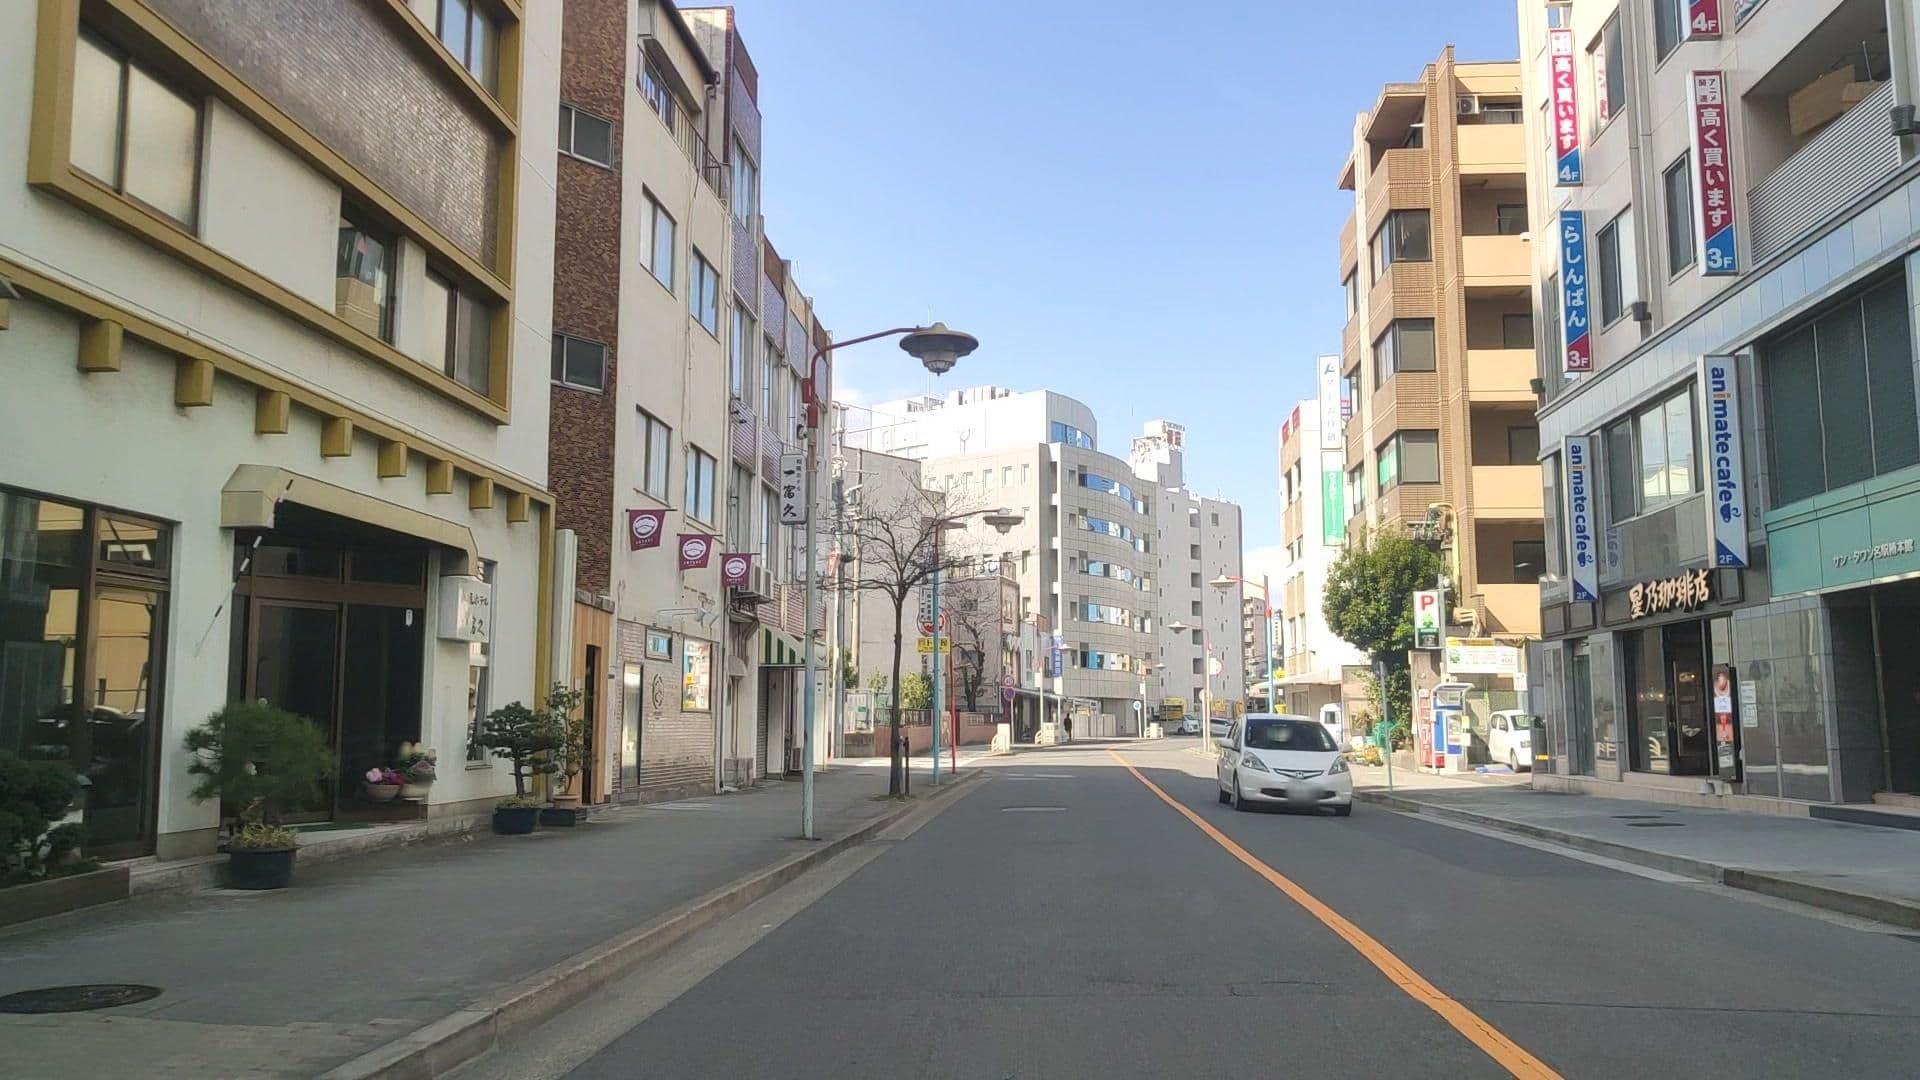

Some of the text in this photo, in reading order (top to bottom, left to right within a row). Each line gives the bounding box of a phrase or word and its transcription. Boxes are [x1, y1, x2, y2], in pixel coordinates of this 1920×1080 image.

[1692, 12, 1718, 32] 4F
[1554, 57, 1576, 150] 高く買います
[1559, 165, 1580, 181] 4F
[1700, 107, 1728, 228] 高く買います
[1707, 247, 1733, 269] 3F
[1564, 225, 1586, 327] らしんばん
[1568, 350, 1589, 368] 3F
[1719, 554, 1733, 564] 2F
[1420, 594, 1435, 610] P
[1576, 591, 1588, 600] 2F
[1629, 568, 1710, 620] 星乃珈琲店
